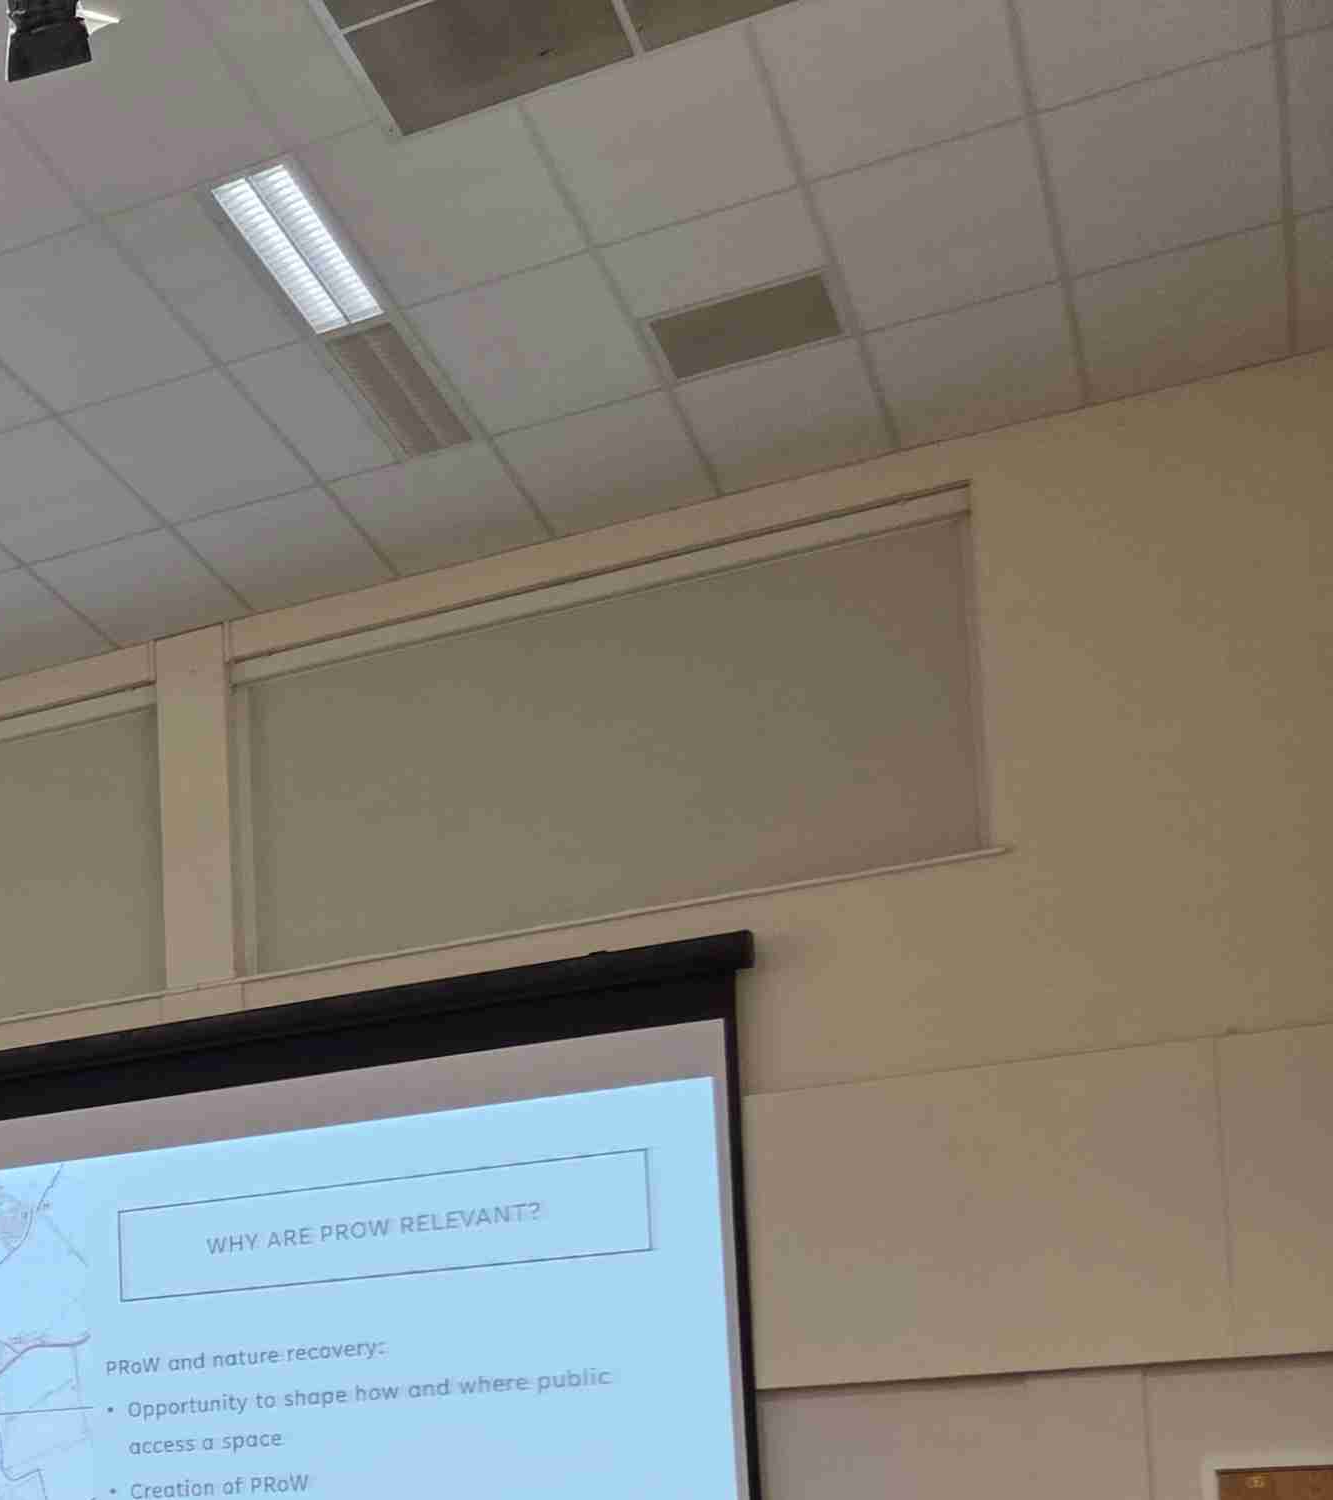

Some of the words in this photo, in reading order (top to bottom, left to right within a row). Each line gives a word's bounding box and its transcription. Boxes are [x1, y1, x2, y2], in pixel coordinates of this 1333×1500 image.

[206, 1232, 259, 1255] WHY
[267, 1227, 314, 1248] ARE
[320, 1218, 394, 1242] PROW
[399, 1200, 542, 1235] RELEVANT?
[105, 1356, 161, 1376] PRoW
[168, 1352, 208, 1372] and
[211, 1349, 281, 1369] nature
[128, 1393, 249, 1422] Opportunity
[255, 1392, 277, 1408] to
[283, 1387, 348, 1413] shape
[354, 1381, 402, 1403] how
[407, 1376, 454, 1399] and
[458, 1374, 532, 1396] where
[536, 1368, 613, 1395] public
[129, 1438, 197, 1456] access
[201, 1437, 216, 1452] a
[221, 1433, 285, 1454] space
[131, 1477, 216, 1500] Creation
[222, 1476, 246, 1495] of
[250, 1472, 310, 1495] PRoW
